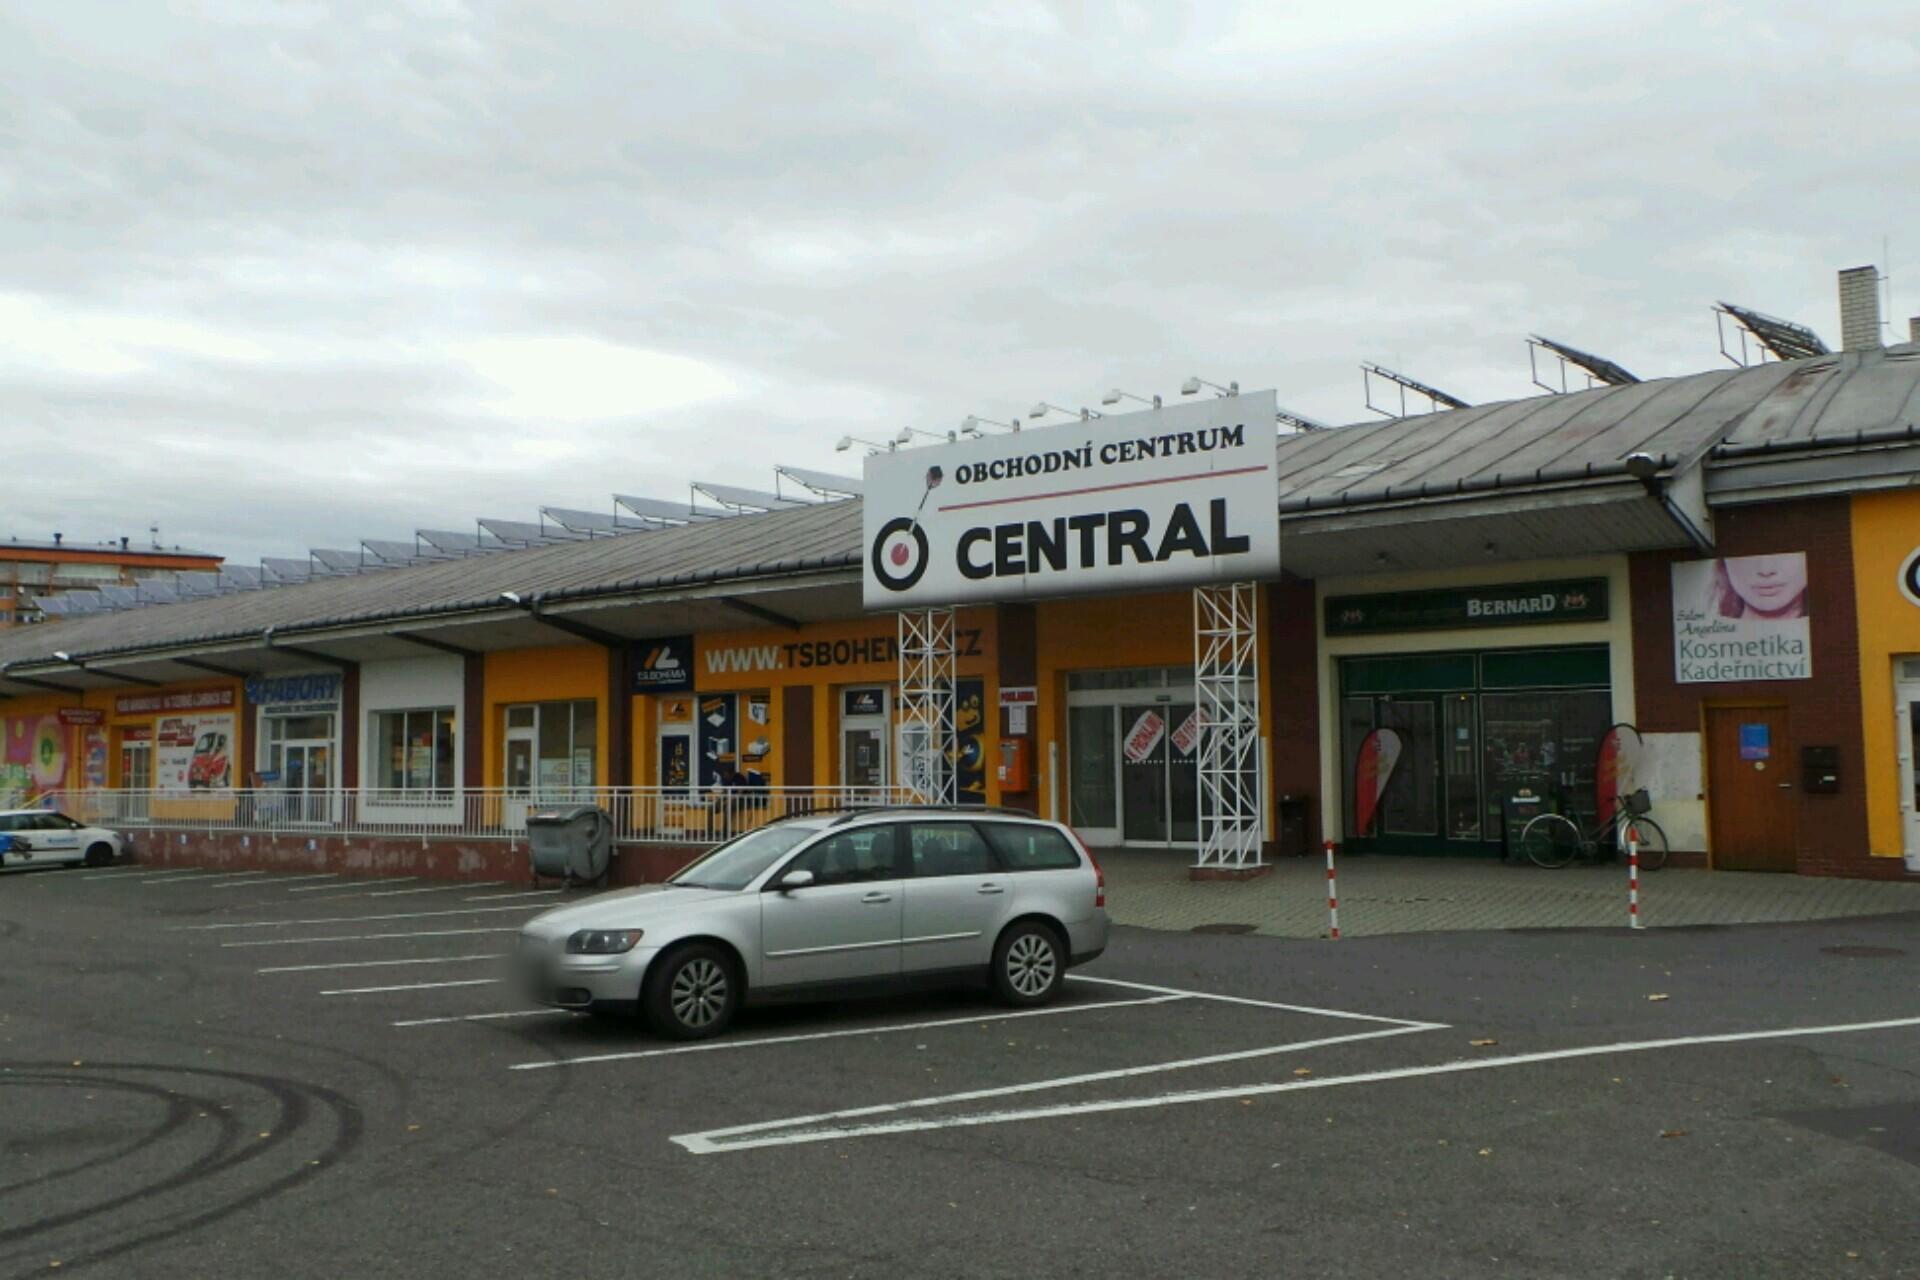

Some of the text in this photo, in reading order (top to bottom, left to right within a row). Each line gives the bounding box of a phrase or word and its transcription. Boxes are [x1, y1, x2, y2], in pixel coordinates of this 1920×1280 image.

[955, 424, 1245, 485] OBCHODNÍ CENTRUM
[956, 498, 1251, 580] CENTRAL
[1467, 594, 1555, 617] BERNARD
[1680, 634, 1804, 659] Kosmetika
[1680, 658, 1806, 680] Kadeřnictví
